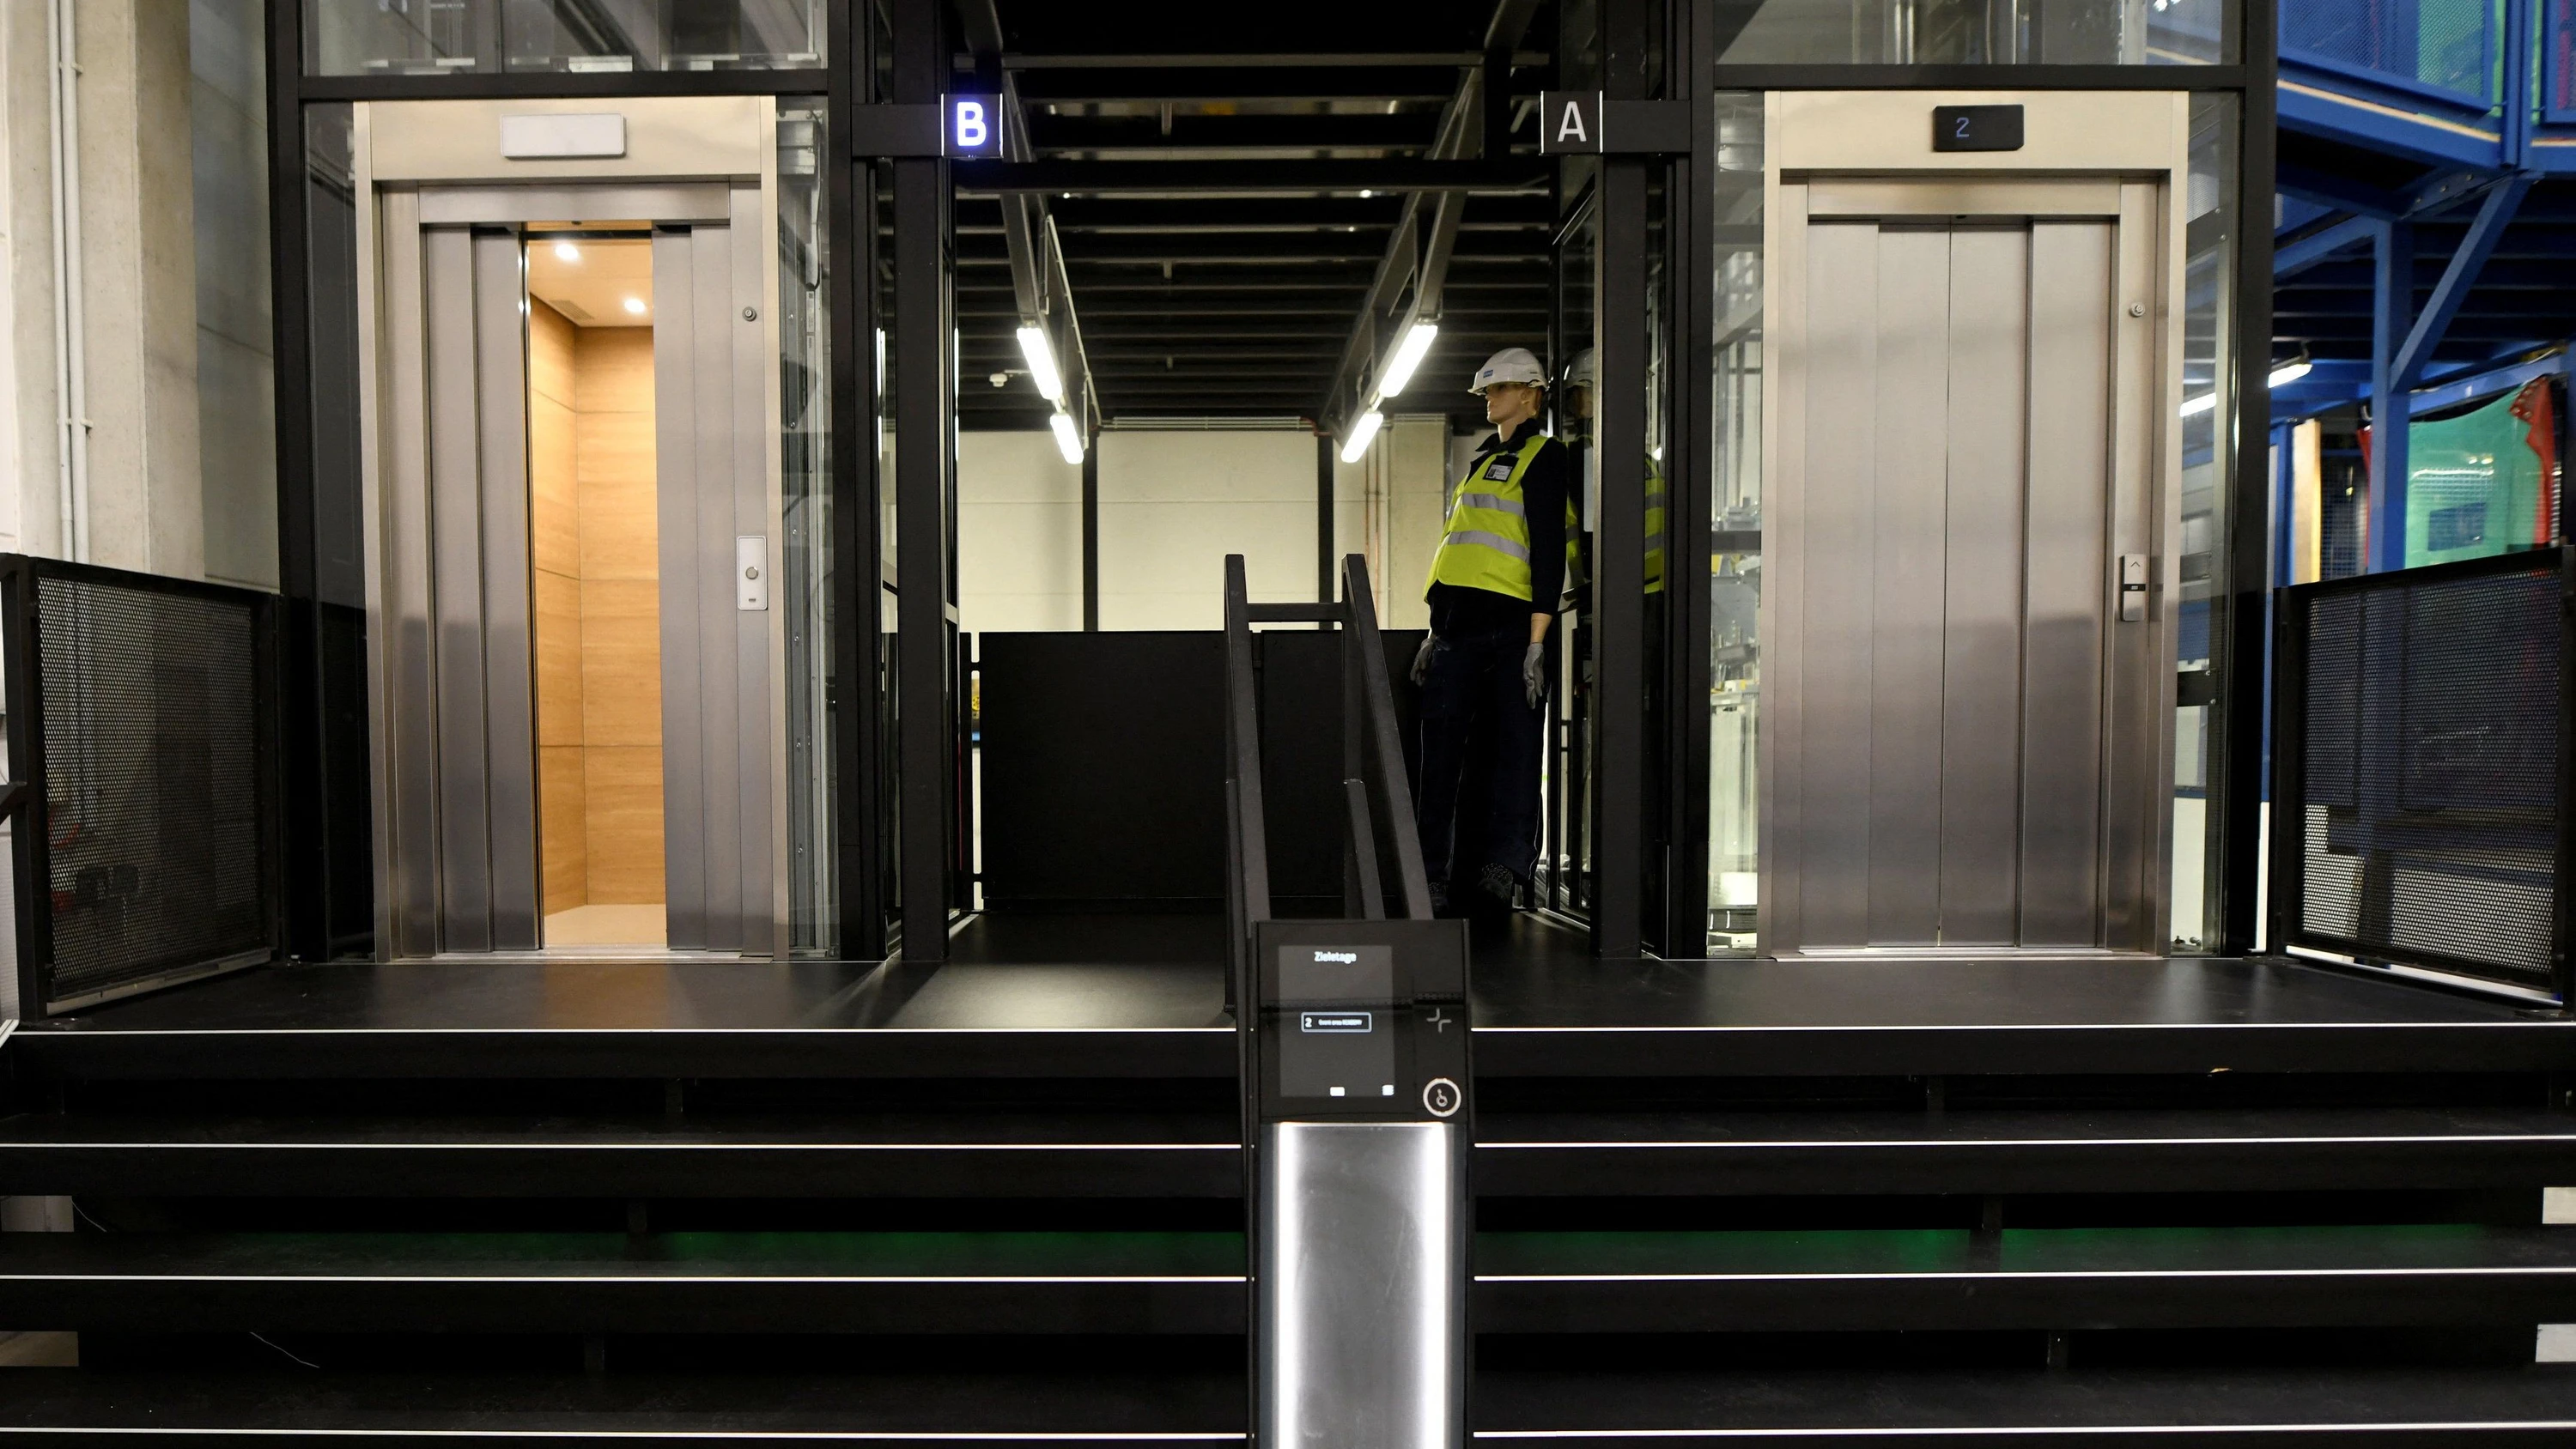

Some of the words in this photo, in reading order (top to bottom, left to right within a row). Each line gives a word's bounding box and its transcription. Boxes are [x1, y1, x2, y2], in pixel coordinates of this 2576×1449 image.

[957, 101, 987, 146] B
[1558, 101, 1587, 142] A
[1956, 117, 1970, 138] 2
[1314, 951, 1357, 964] Zieletage
[1304, 1016, 1312, 1028] 2
